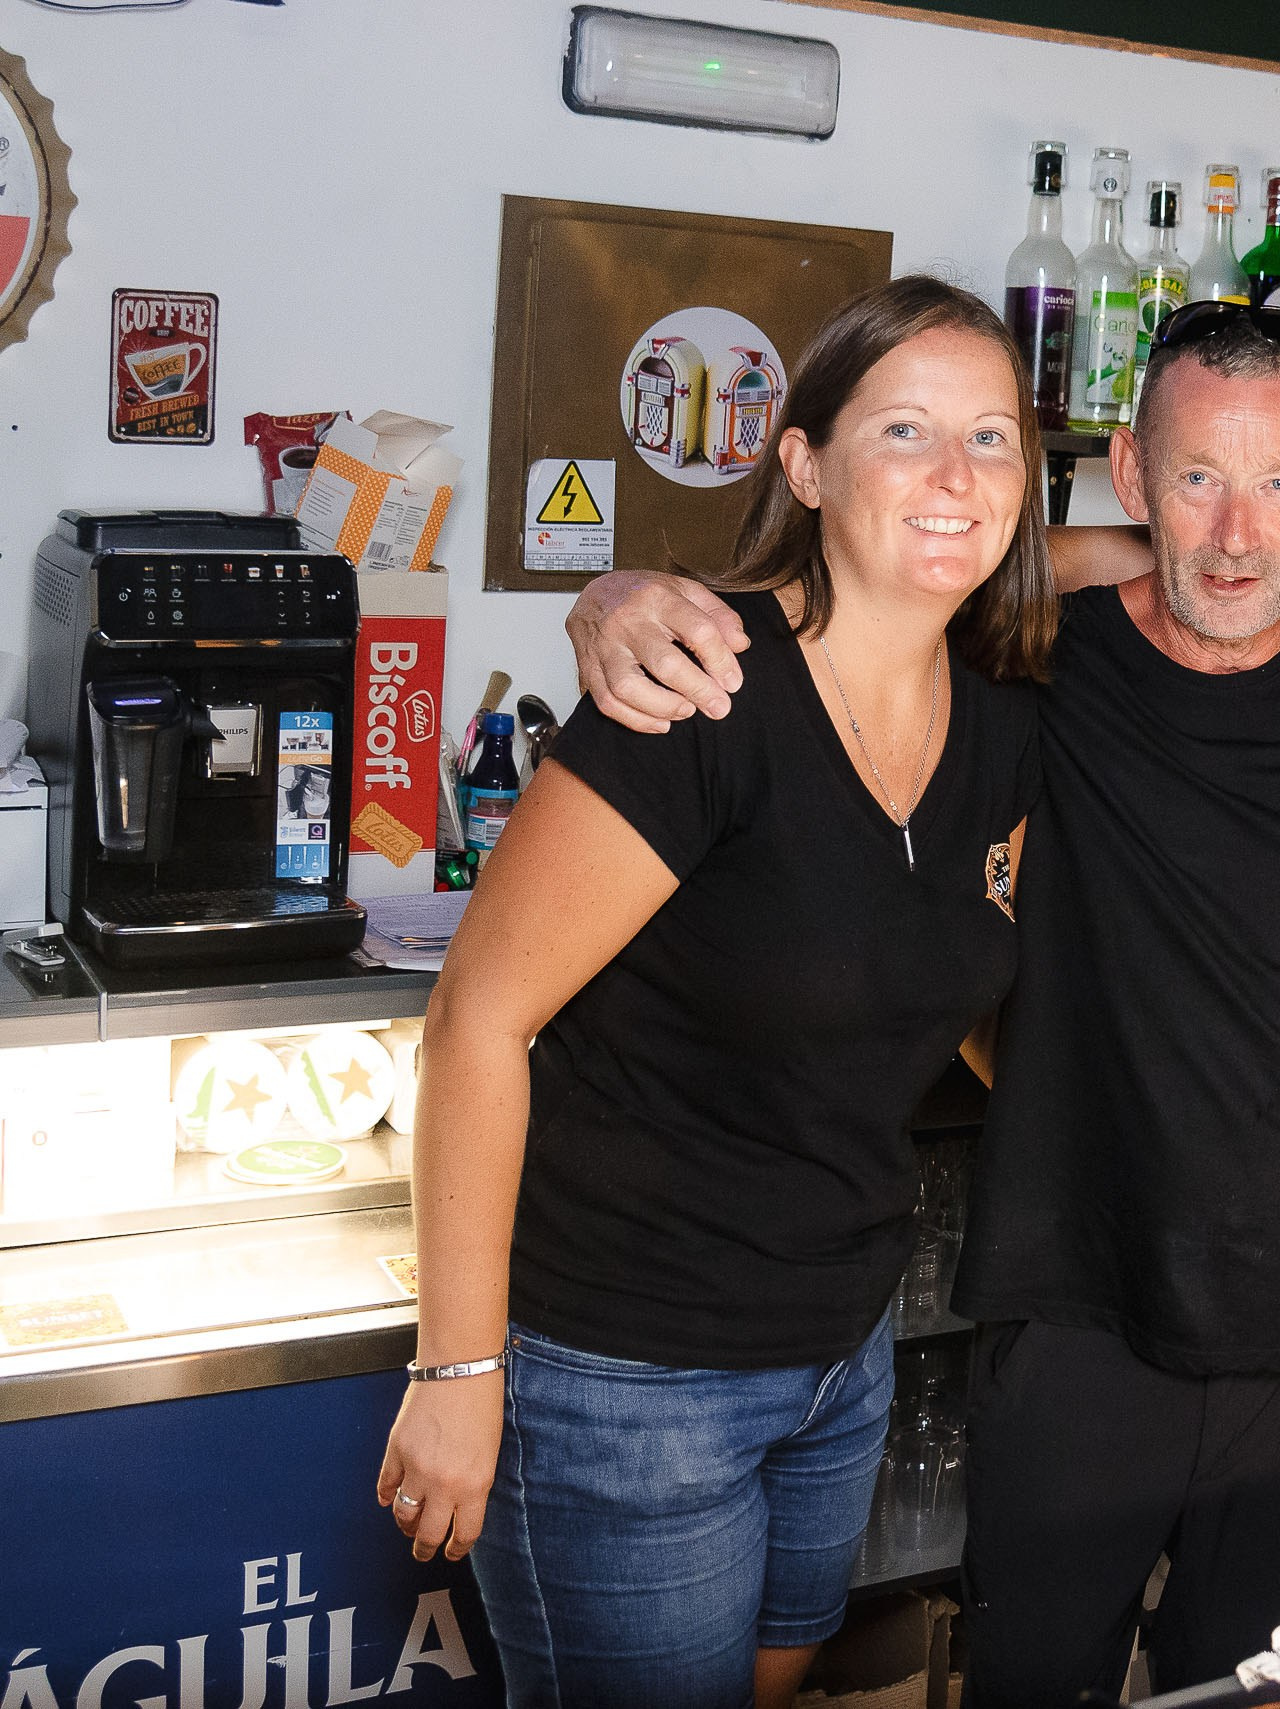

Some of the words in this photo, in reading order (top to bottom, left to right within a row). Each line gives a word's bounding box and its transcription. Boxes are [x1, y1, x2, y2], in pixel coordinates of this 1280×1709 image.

[120, 299, 209, 338] COFFEE
[130, 402, 160, 421] FRESH
[162, 395, 200, 413] BREWED
[137, 420, 157, 433] BEST
[294, 715, 320, 728] 12x
[364, 642, 419, 790] Biscoff
[994, 875, 1011, 896] SUN
[243, 1552, 318, 1615] EL
[0, 1589, 478, 1709] ÁGUILA
